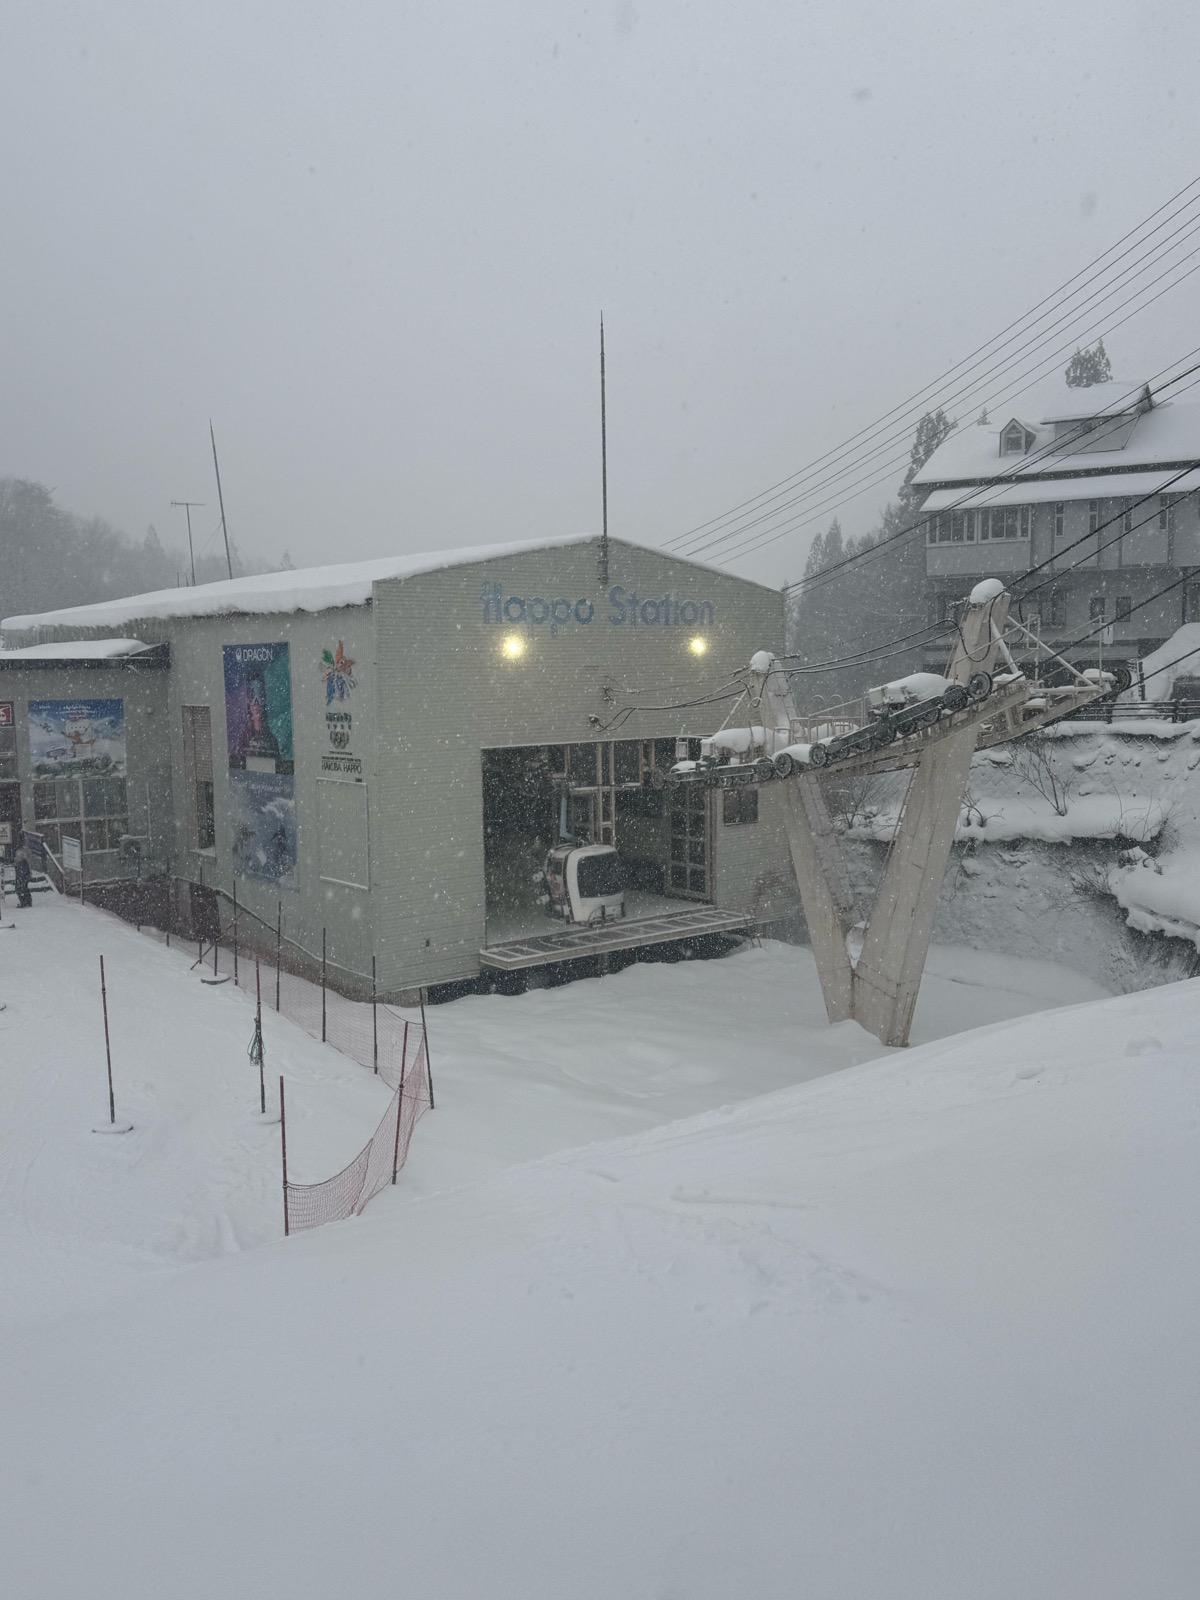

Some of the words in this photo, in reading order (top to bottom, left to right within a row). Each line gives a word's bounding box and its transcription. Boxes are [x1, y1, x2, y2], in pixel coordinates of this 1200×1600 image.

[481, 582, 593, 638] Happo
[609, 585, 714, 626] Station
[243, 648, 273, 661] DRAGON
[322, 762, 342, 772] HAKUBA
[343, 764, 362, 774] HAPPO
